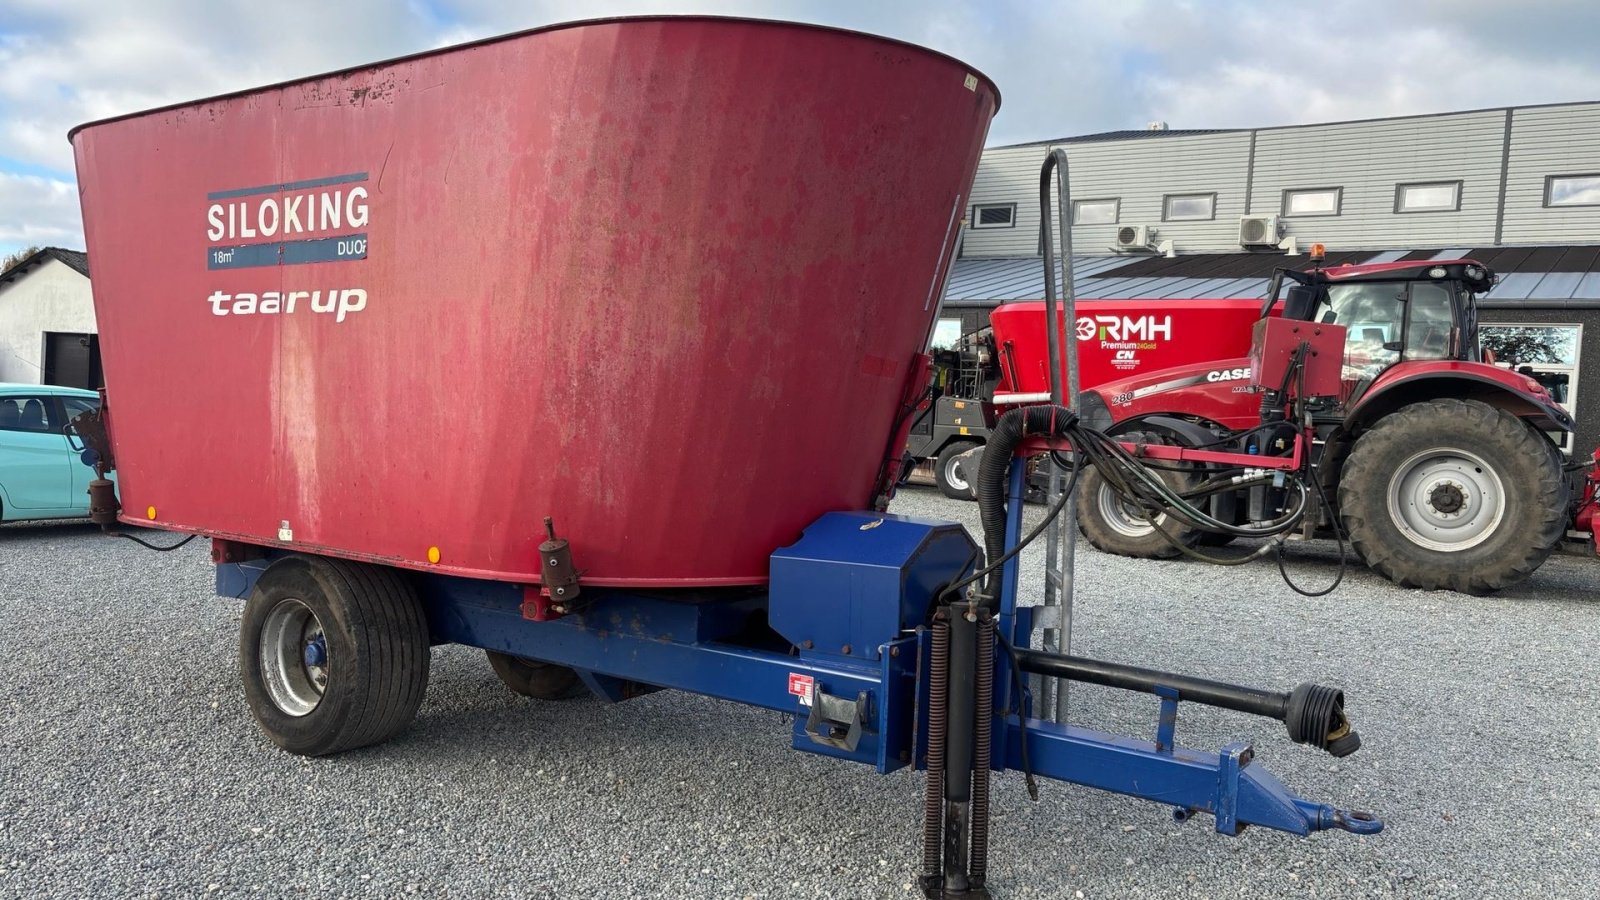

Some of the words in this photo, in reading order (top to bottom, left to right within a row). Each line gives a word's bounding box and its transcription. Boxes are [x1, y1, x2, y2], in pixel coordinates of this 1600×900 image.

[207, 186, 369, 242] SILOKING
[207, 288, 368, 323] taarup
[1096, 314, 1172, 341] RMH
[1116, 350, 1135, 360] CN
[1207, 368, 1251, 382] CASE
[1111, 391, 1134, 406] 280
